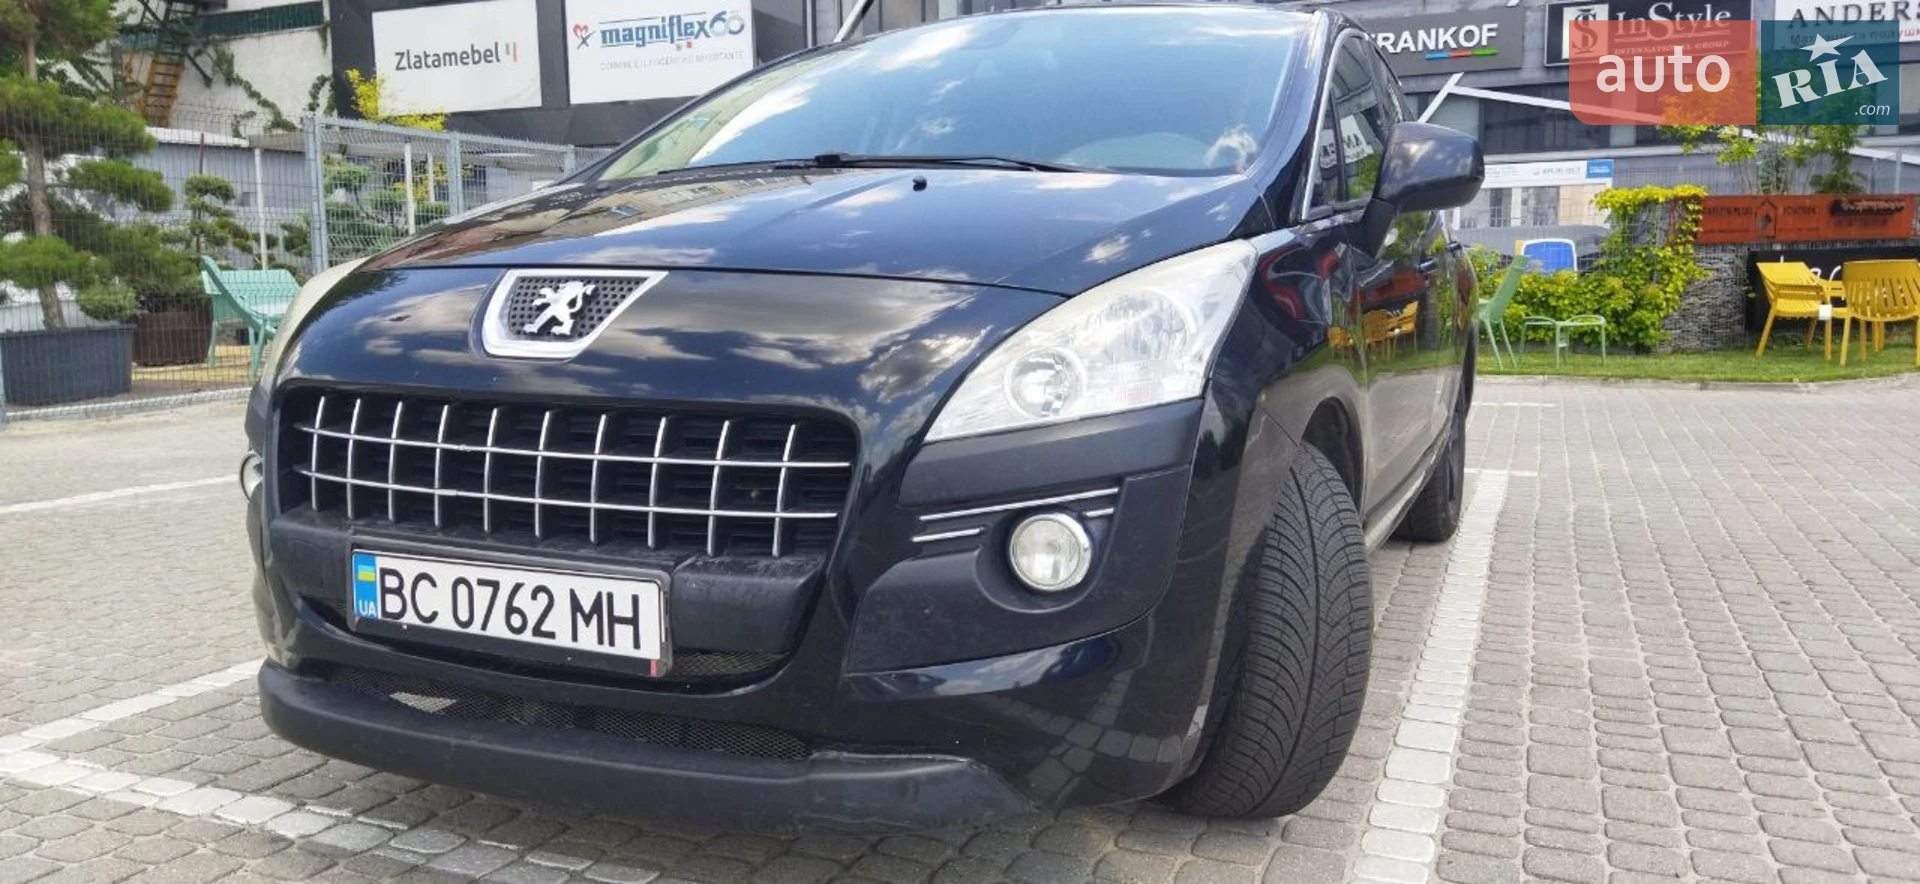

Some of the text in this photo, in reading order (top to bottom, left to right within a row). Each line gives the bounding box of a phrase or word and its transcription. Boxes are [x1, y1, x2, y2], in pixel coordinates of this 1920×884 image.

[1614, 2, 1732, 41] InStyle
[1787, 1, 1920, 29] ANDER
[600, 15, 711, 48] magniflex
[1369, 23, 1499, 54] RANKOF
[395, 41, 501, 71] Zlatamebel
[1614, 40, 1730, 55] INTERNATIOAL GROUP
[359, 600, 377, 617] UA
[379, 567, 642, 650] BC 0762 MH
